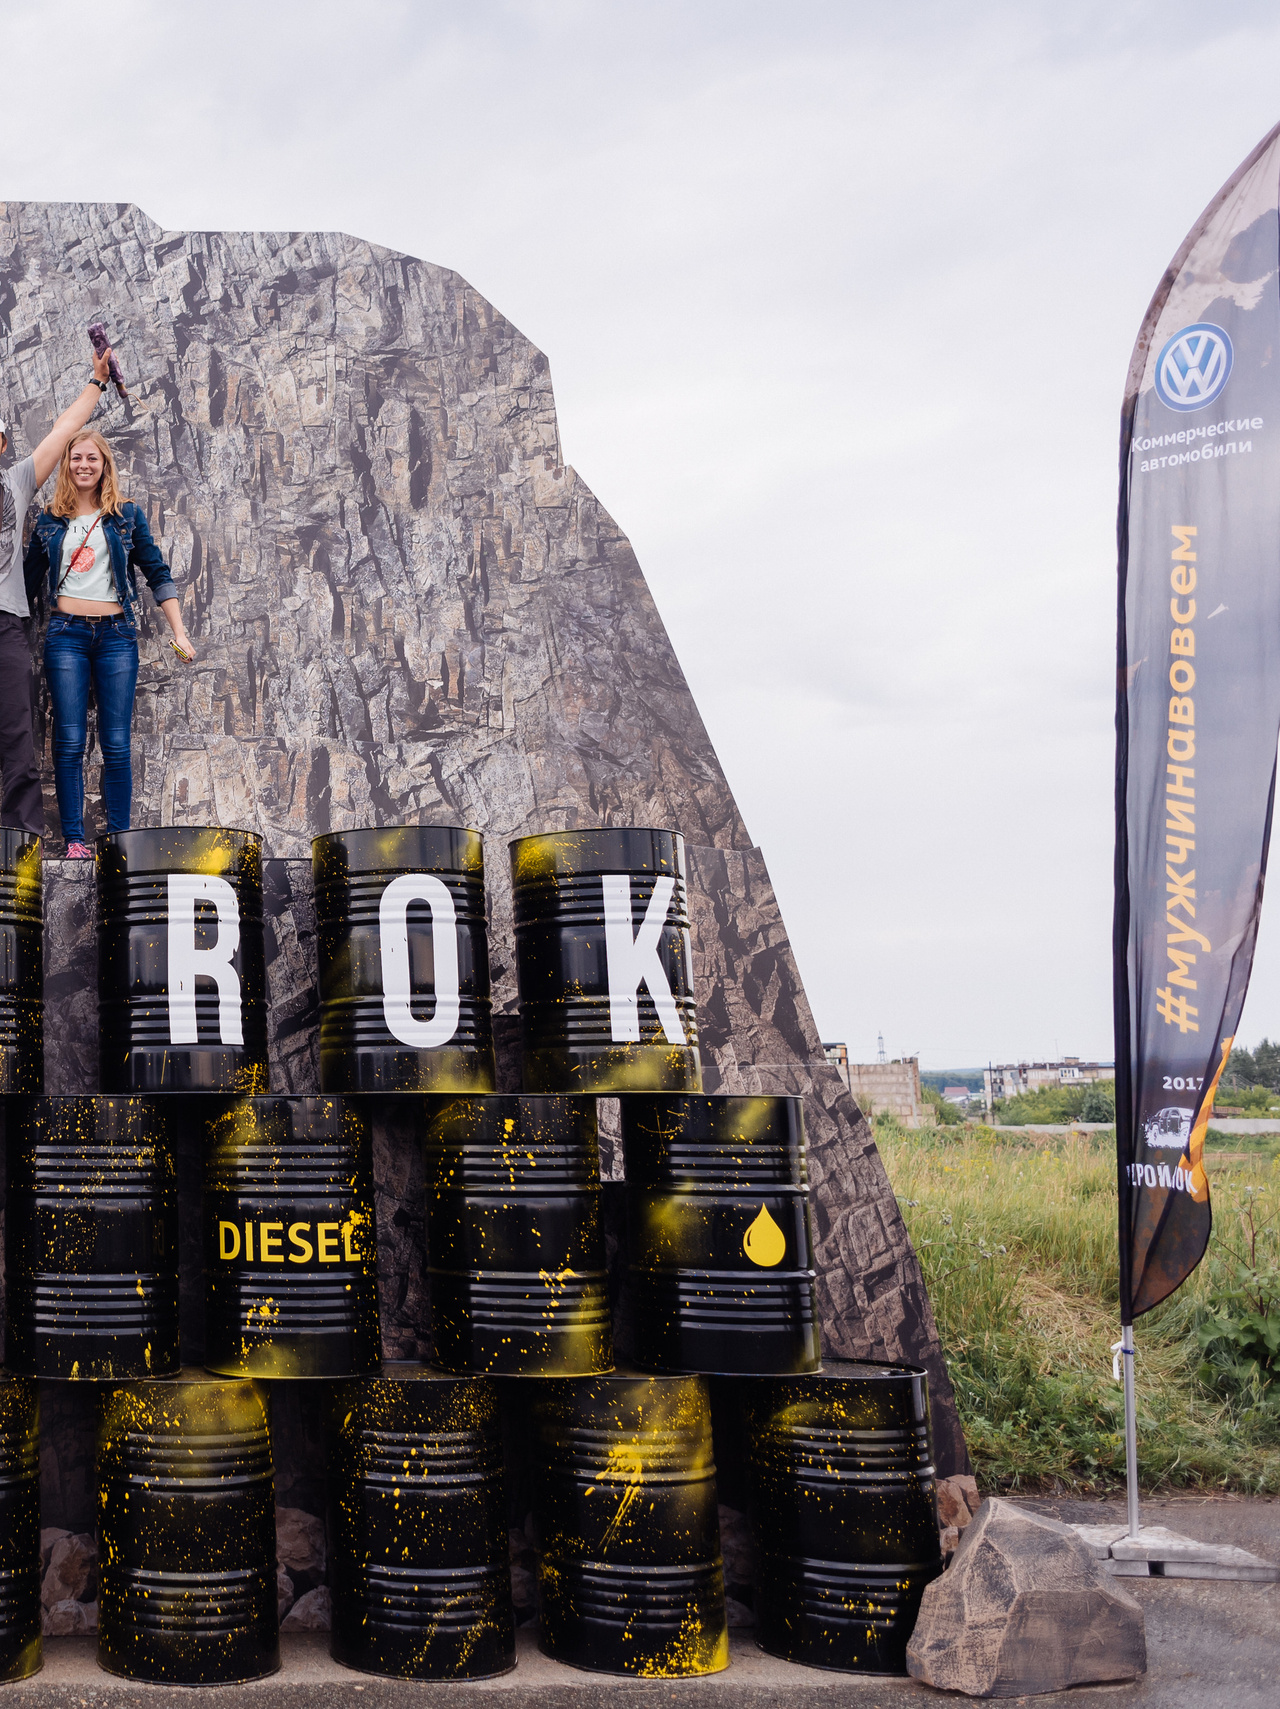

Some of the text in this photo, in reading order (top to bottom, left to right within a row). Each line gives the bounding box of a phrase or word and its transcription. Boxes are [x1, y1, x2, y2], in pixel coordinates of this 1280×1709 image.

[1132, 417, 1263, 452] Коммерческие
[1141, 441, 1252, 472] автомобили
[1156, 525, 1212, 1034] #мужчинавовсем
[219, 1220, 362, 1264] DIESEL
